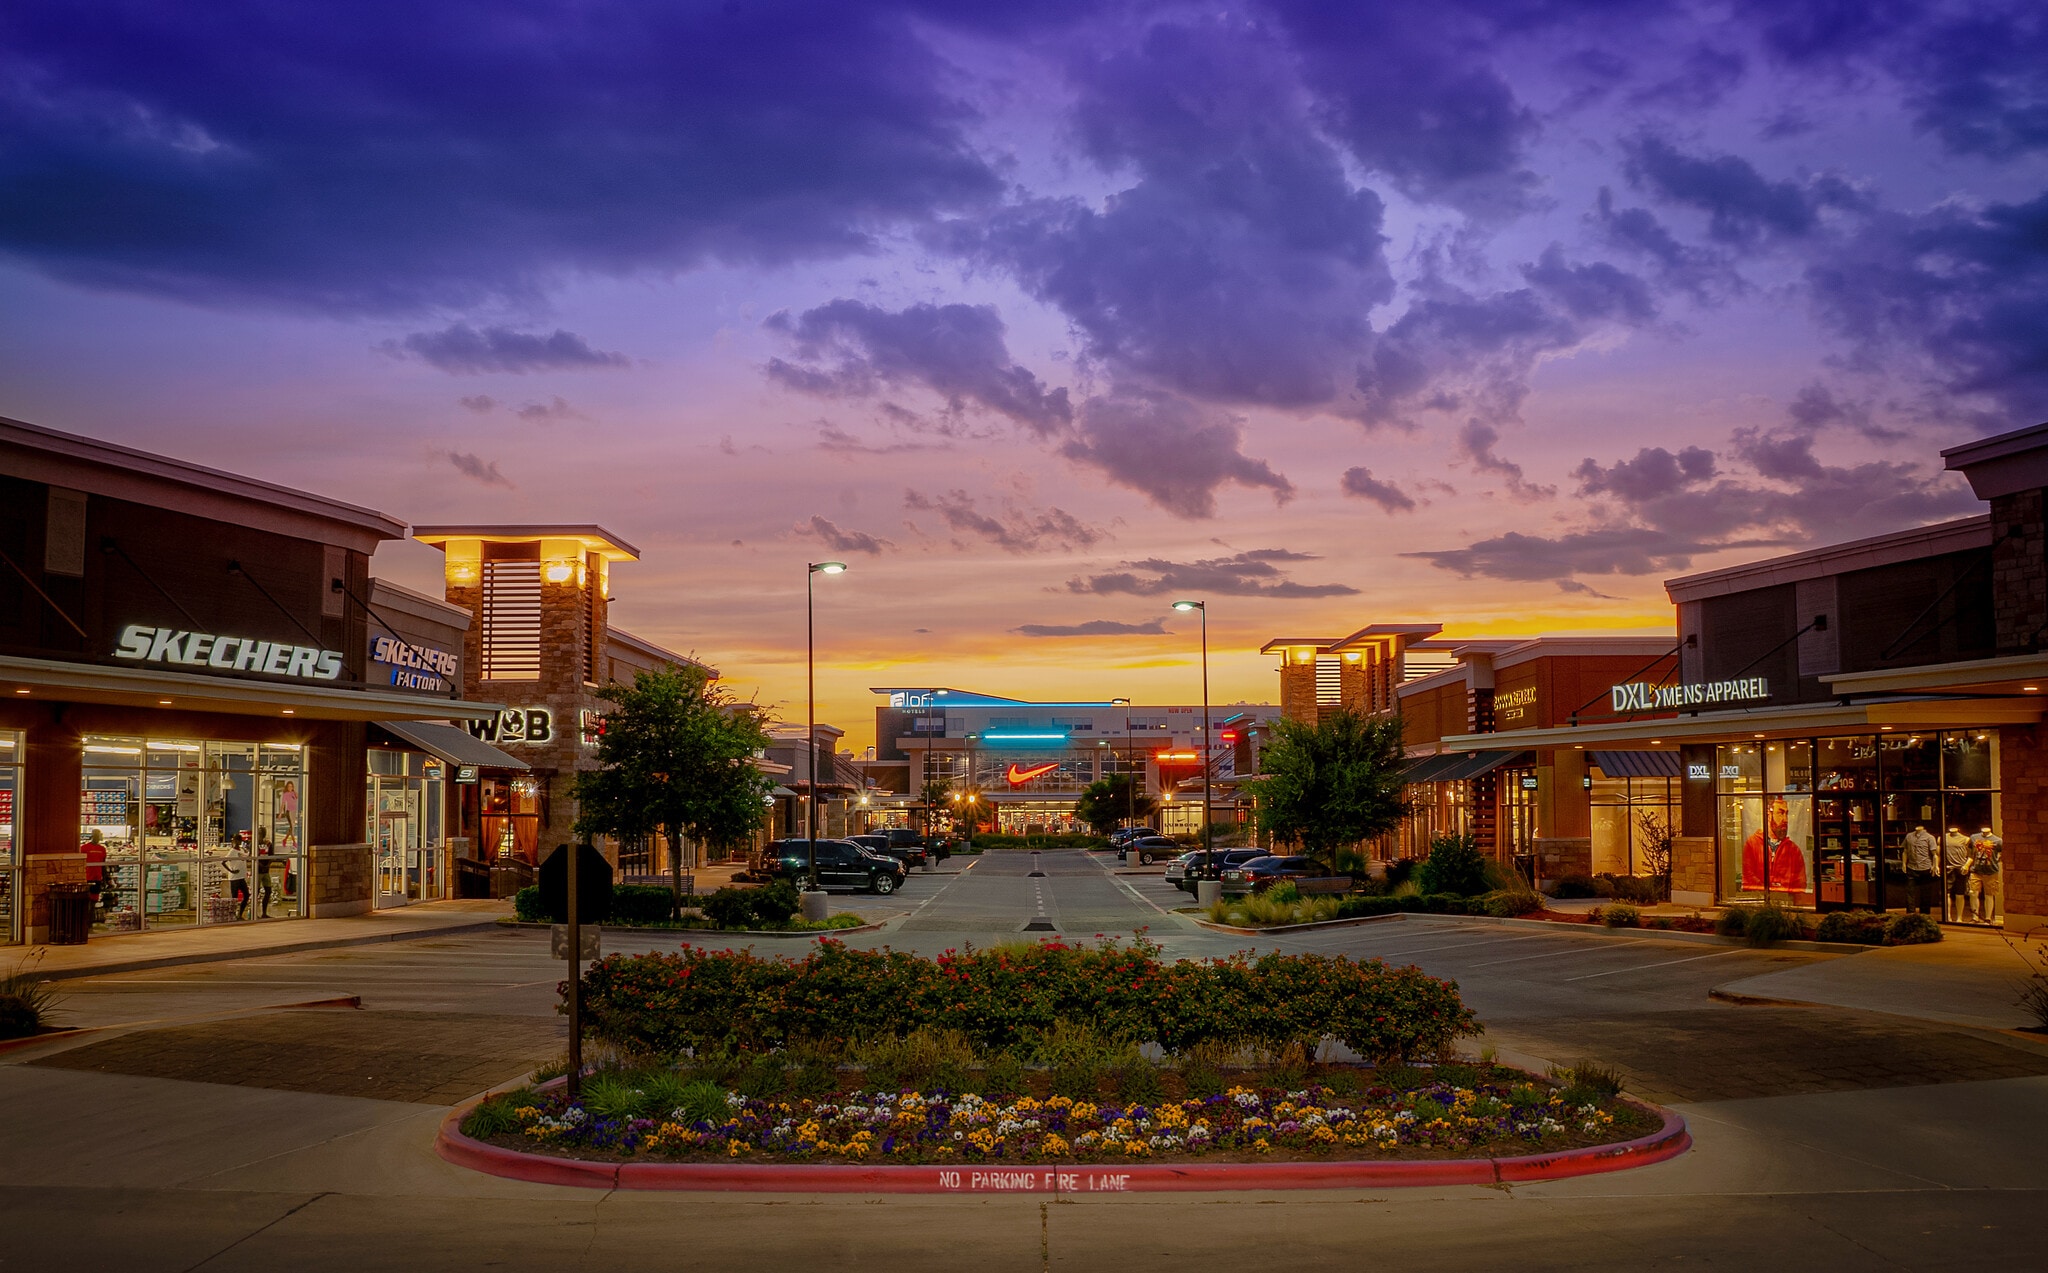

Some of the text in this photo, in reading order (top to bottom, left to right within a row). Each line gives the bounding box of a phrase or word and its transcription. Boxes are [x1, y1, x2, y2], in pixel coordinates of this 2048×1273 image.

[115, 625, 344, 680] SKECHERS
[374, 636, 458, 676] SKECHERS
[396, 671, 443, 691] FACTORY
[890, 691, 934, 707] aloft
[1612, 682, 1653, 711] DXL
[1706, 677, 1768, 702] APPAREL
[1689, 765, 1710, 776] DXL
[1839, 778, 1854, 789] 105
[939, 1171, 960, 1189] NO
[971, 1171, 1035, 1190] PARKING
[1089, 1174, 1130, 1191] LANE
